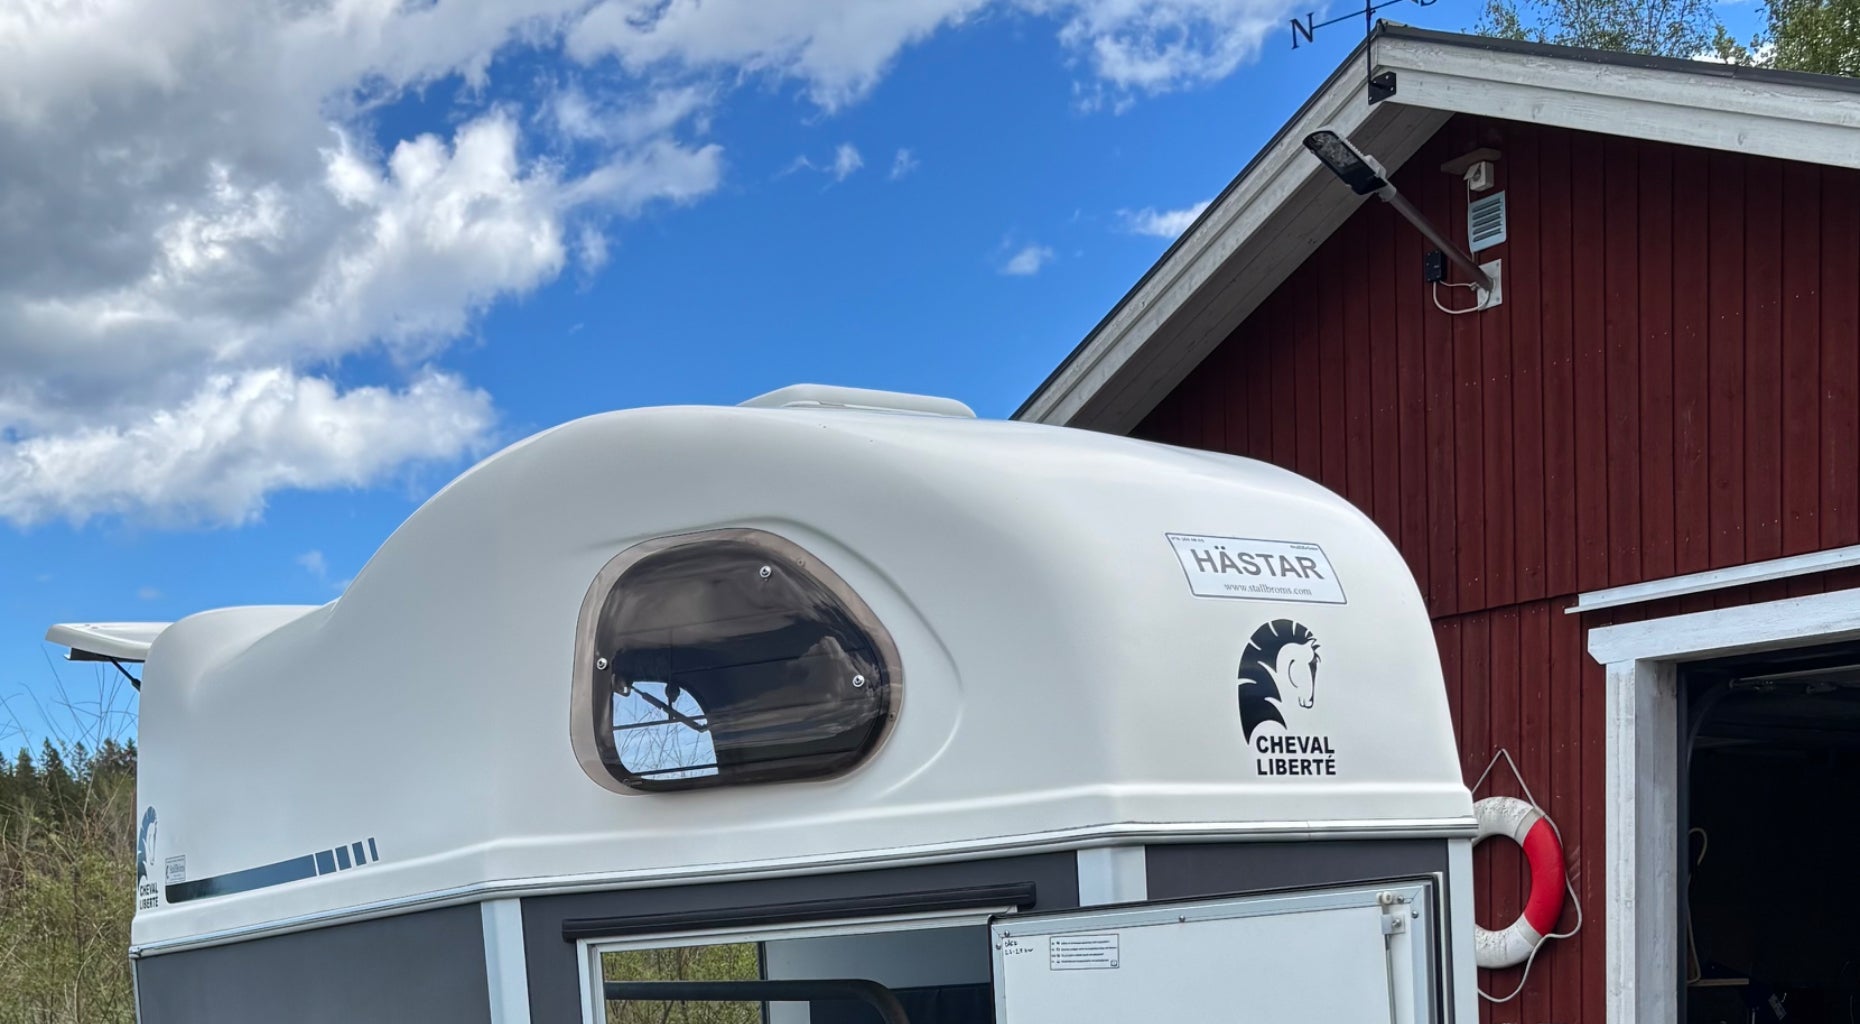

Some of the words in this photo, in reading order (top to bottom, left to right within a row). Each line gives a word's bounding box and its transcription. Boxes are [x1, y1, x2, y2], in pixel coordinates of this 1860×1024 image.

[1289, 12, 1314, 50] N
[1189, 545, 1325, 580] HÄSTAR
[1223, 582, 1312, 597] www.stallbroms.com
[1256, 735, 1335, 754] CHEVAL
[1256, 755, 1336, 776] LIBERTÉ
[140, 882, 159, 897] CHEVAL
